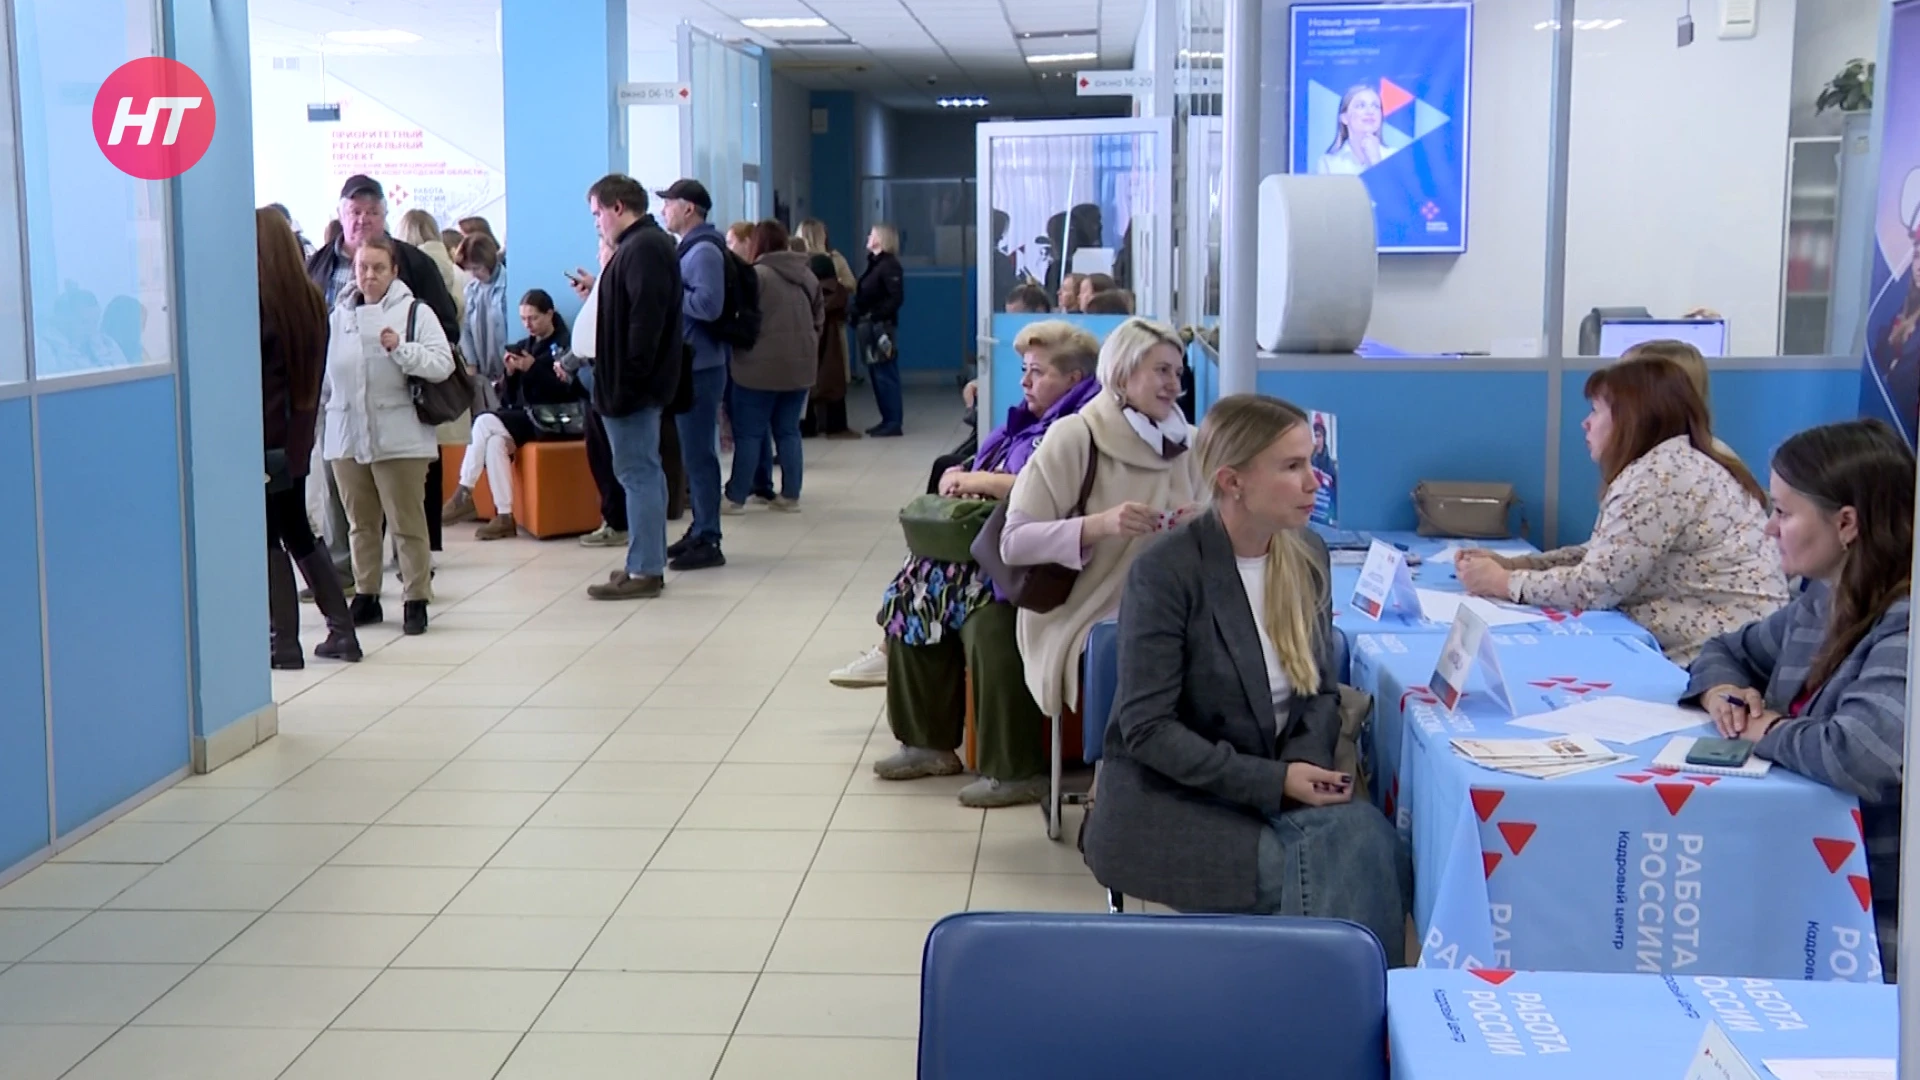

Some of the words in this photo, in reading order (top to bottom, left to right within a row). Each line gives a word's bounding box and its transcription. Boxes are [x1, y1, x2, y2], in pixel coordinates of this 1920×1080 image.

[649, 88, 675, 99] 06-15
[332, 130, 423, 139] ПРИОРИТЕТНЫЙ
[332, 141, 423, 150] РЕГИОНАЛЬНЫЙ
[332, 153, 375, 161] ПРОЕКТ
[1615, 830, 1630, 904] Кадровый
[1612, 907, 1625, 951] центр
[1636, 832, 1669, 973] РОССИИ
[1672, 833, 1704, 970] РАБОТА
[1424, 926, 1484, 970] РАБ
[1490, 903, 1513, 968] РАБ
[1803, 920, 1820, 981] Кадров
[1462, 989, 1527, 1056] РОССИИ
[1507, 991, 1572, 1054] РАБОТА
[1693, 975, 1765, 1032] ОССИИ
[1737, 976, 1809, 1031] АБОТА
